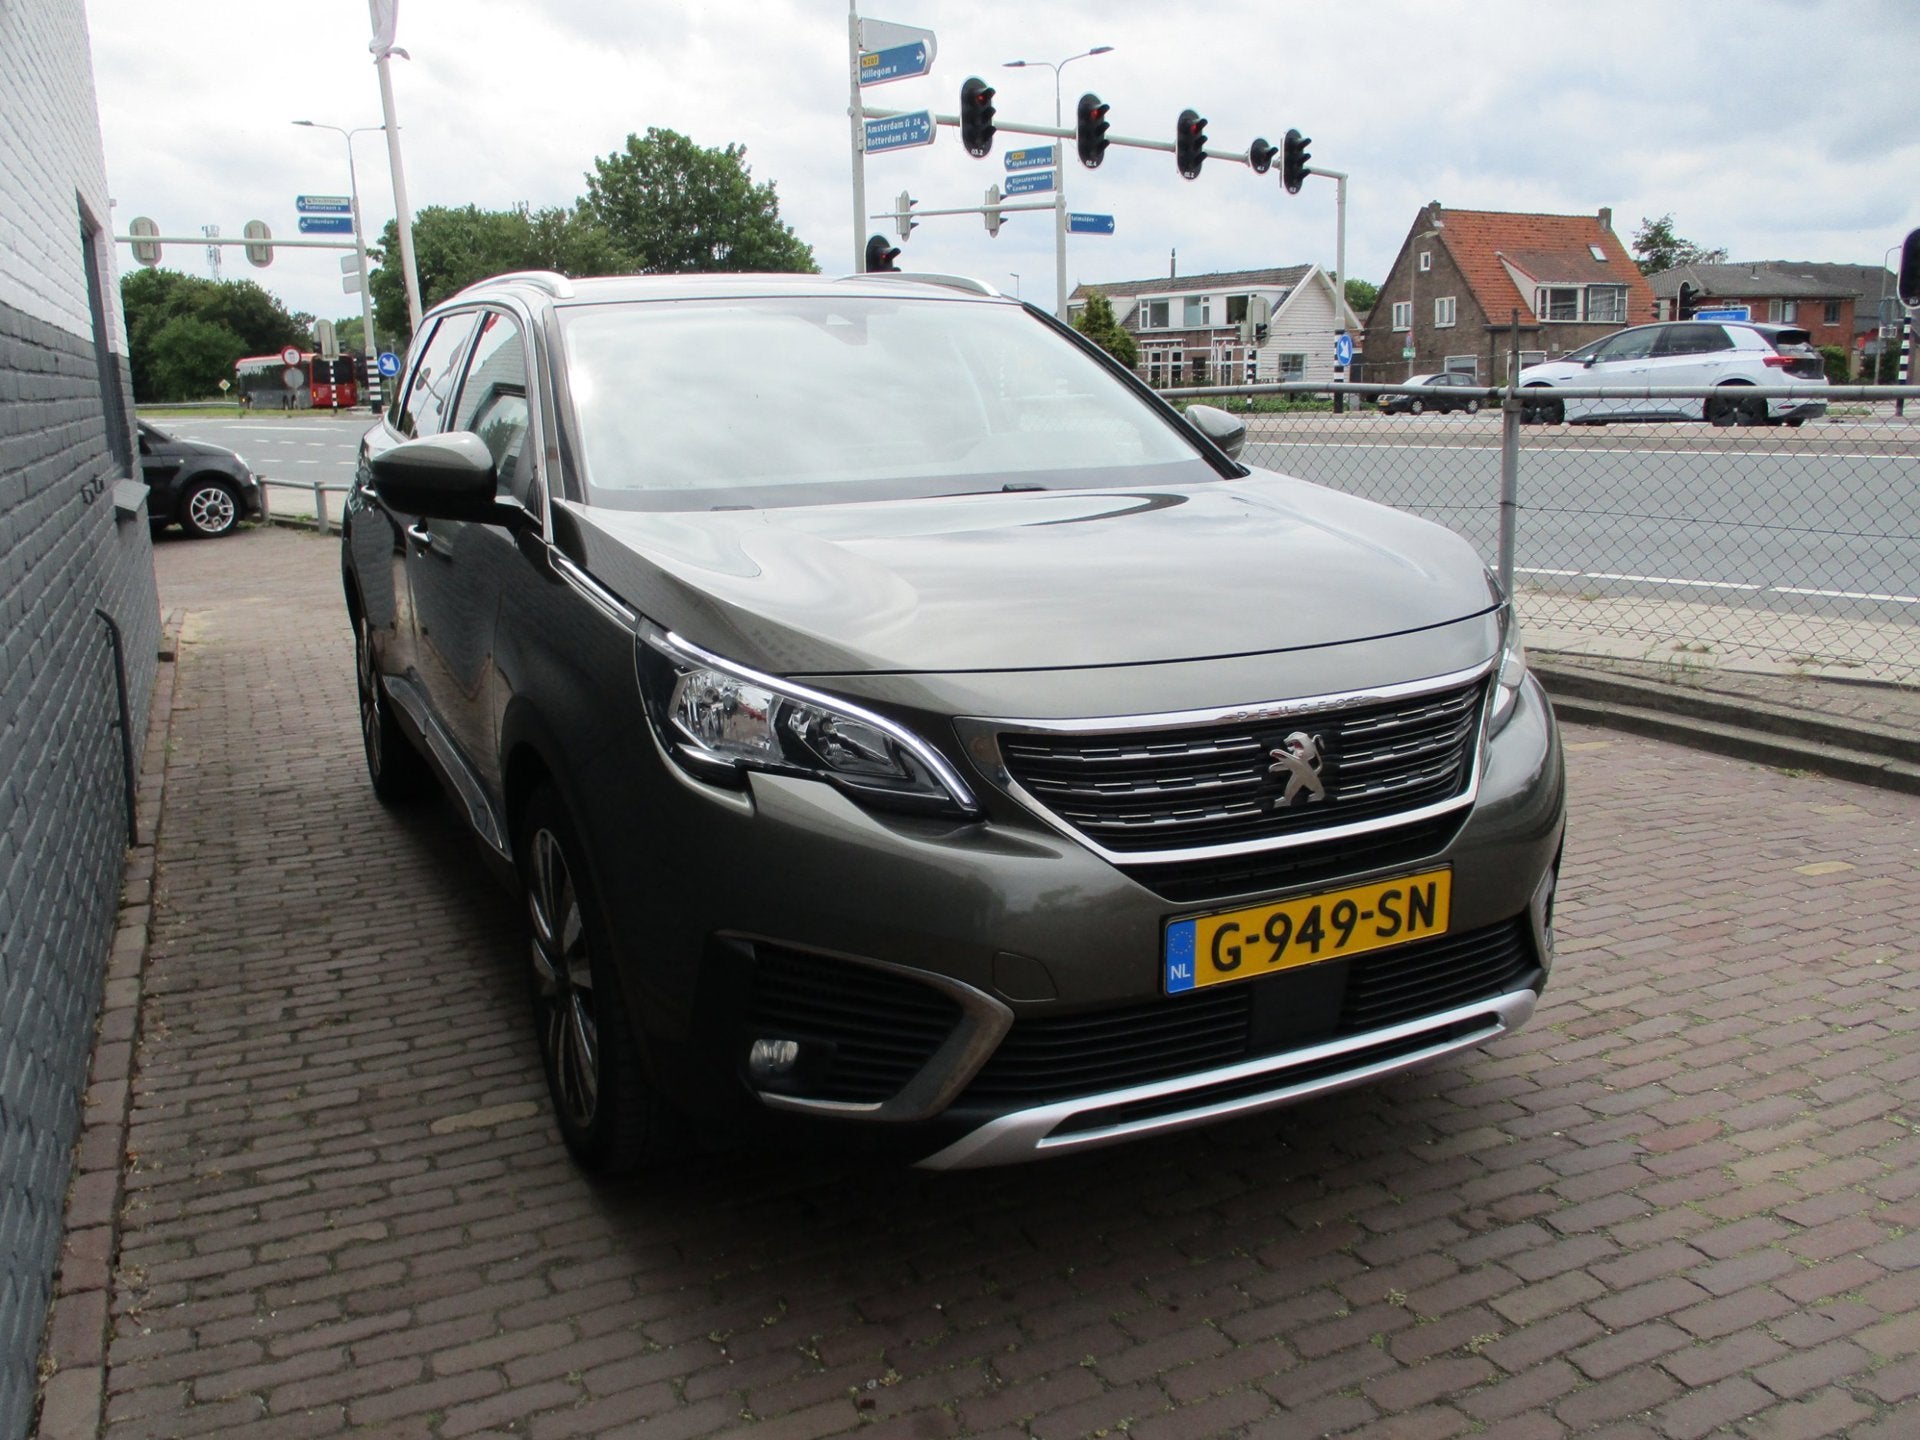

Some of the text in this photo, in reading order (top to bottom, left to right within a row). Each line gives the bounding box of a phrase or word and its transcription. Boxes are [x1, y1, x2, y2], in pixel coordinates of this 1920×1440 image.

[862, 66, 891, 79] Hillegom
[867, 121, 904, 133] Amsterdam
[867, 134, 901, 146] Rotterdam
[1236, 695, 1364, 721] PEUGEOT
[1211, 881, 1437, 973] G-949-SN
[1170, 964, 1191, 981] NL
